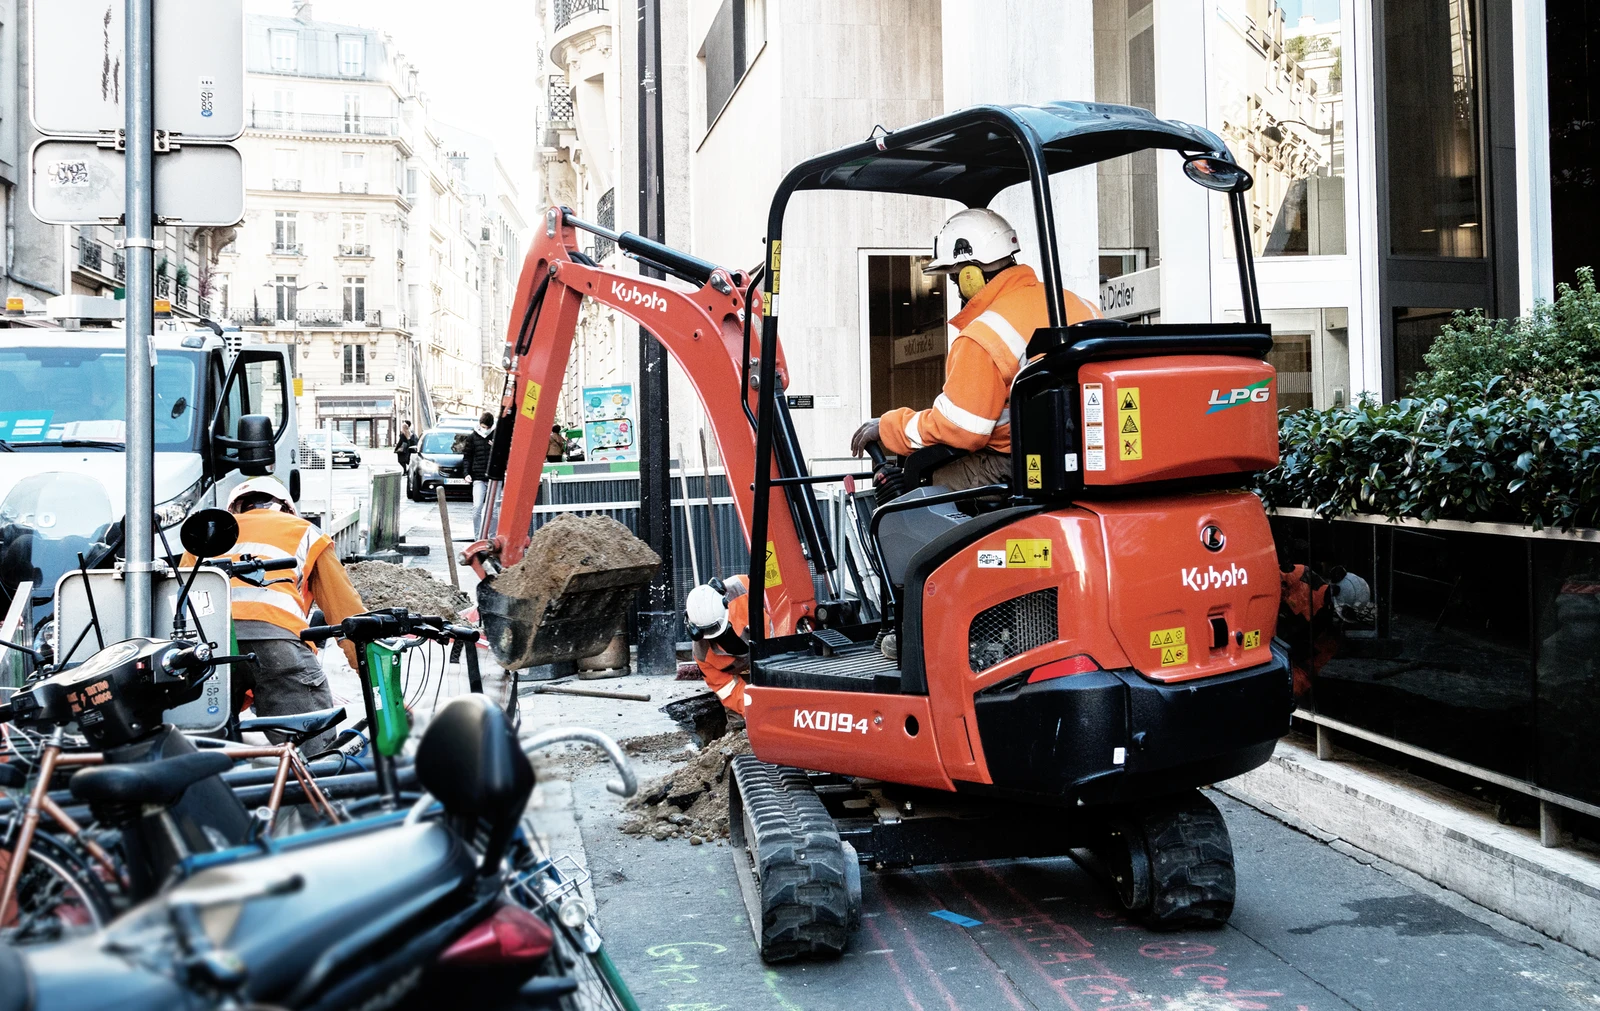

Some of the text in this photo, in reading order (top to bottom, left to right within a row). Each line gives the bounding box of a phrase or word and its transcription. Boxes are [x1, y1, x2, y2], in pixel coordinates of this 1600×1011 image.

[200, 91, 213, 102] SP
[201, 101, 213, 111] 83
[611, 280, 668, 313] Kubota
[1107, 282, 1135, 310] Didier
[1207, 387, 1270, 405] LPG
[1181, 562, 1248, 592] Kubota
[206, 687, 220, 697] SP
[207, 697, 219, 706] 83
[793, 709, 869, 735] KX019-4
